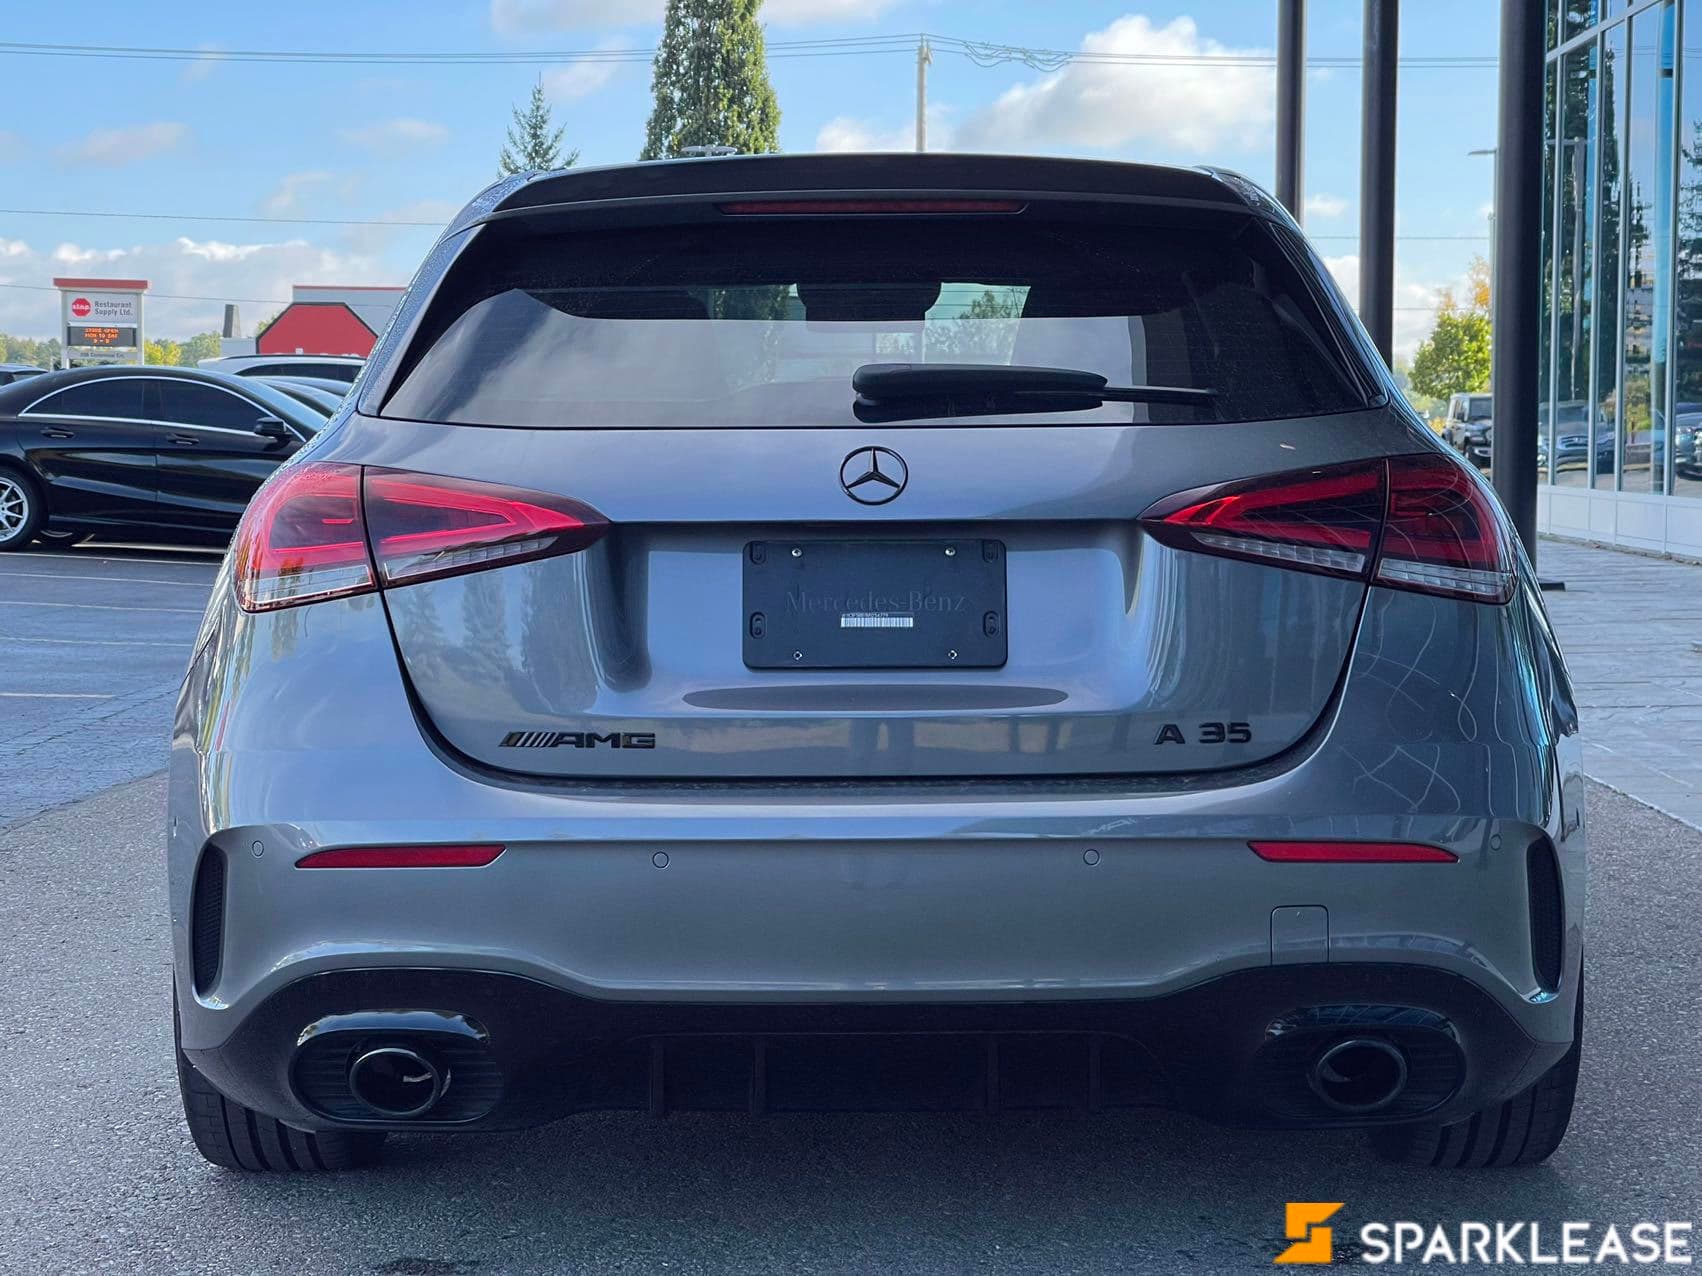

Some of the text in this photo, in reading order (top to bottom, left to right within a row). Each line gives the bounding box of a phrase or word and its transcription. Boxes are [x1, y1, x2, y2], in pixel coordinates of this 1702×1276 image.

[94, 308, 118, 316] Supply
[785, 591, 968, 613] Mercedes-Benz
[1153, 722, 1252, 745] A 35
